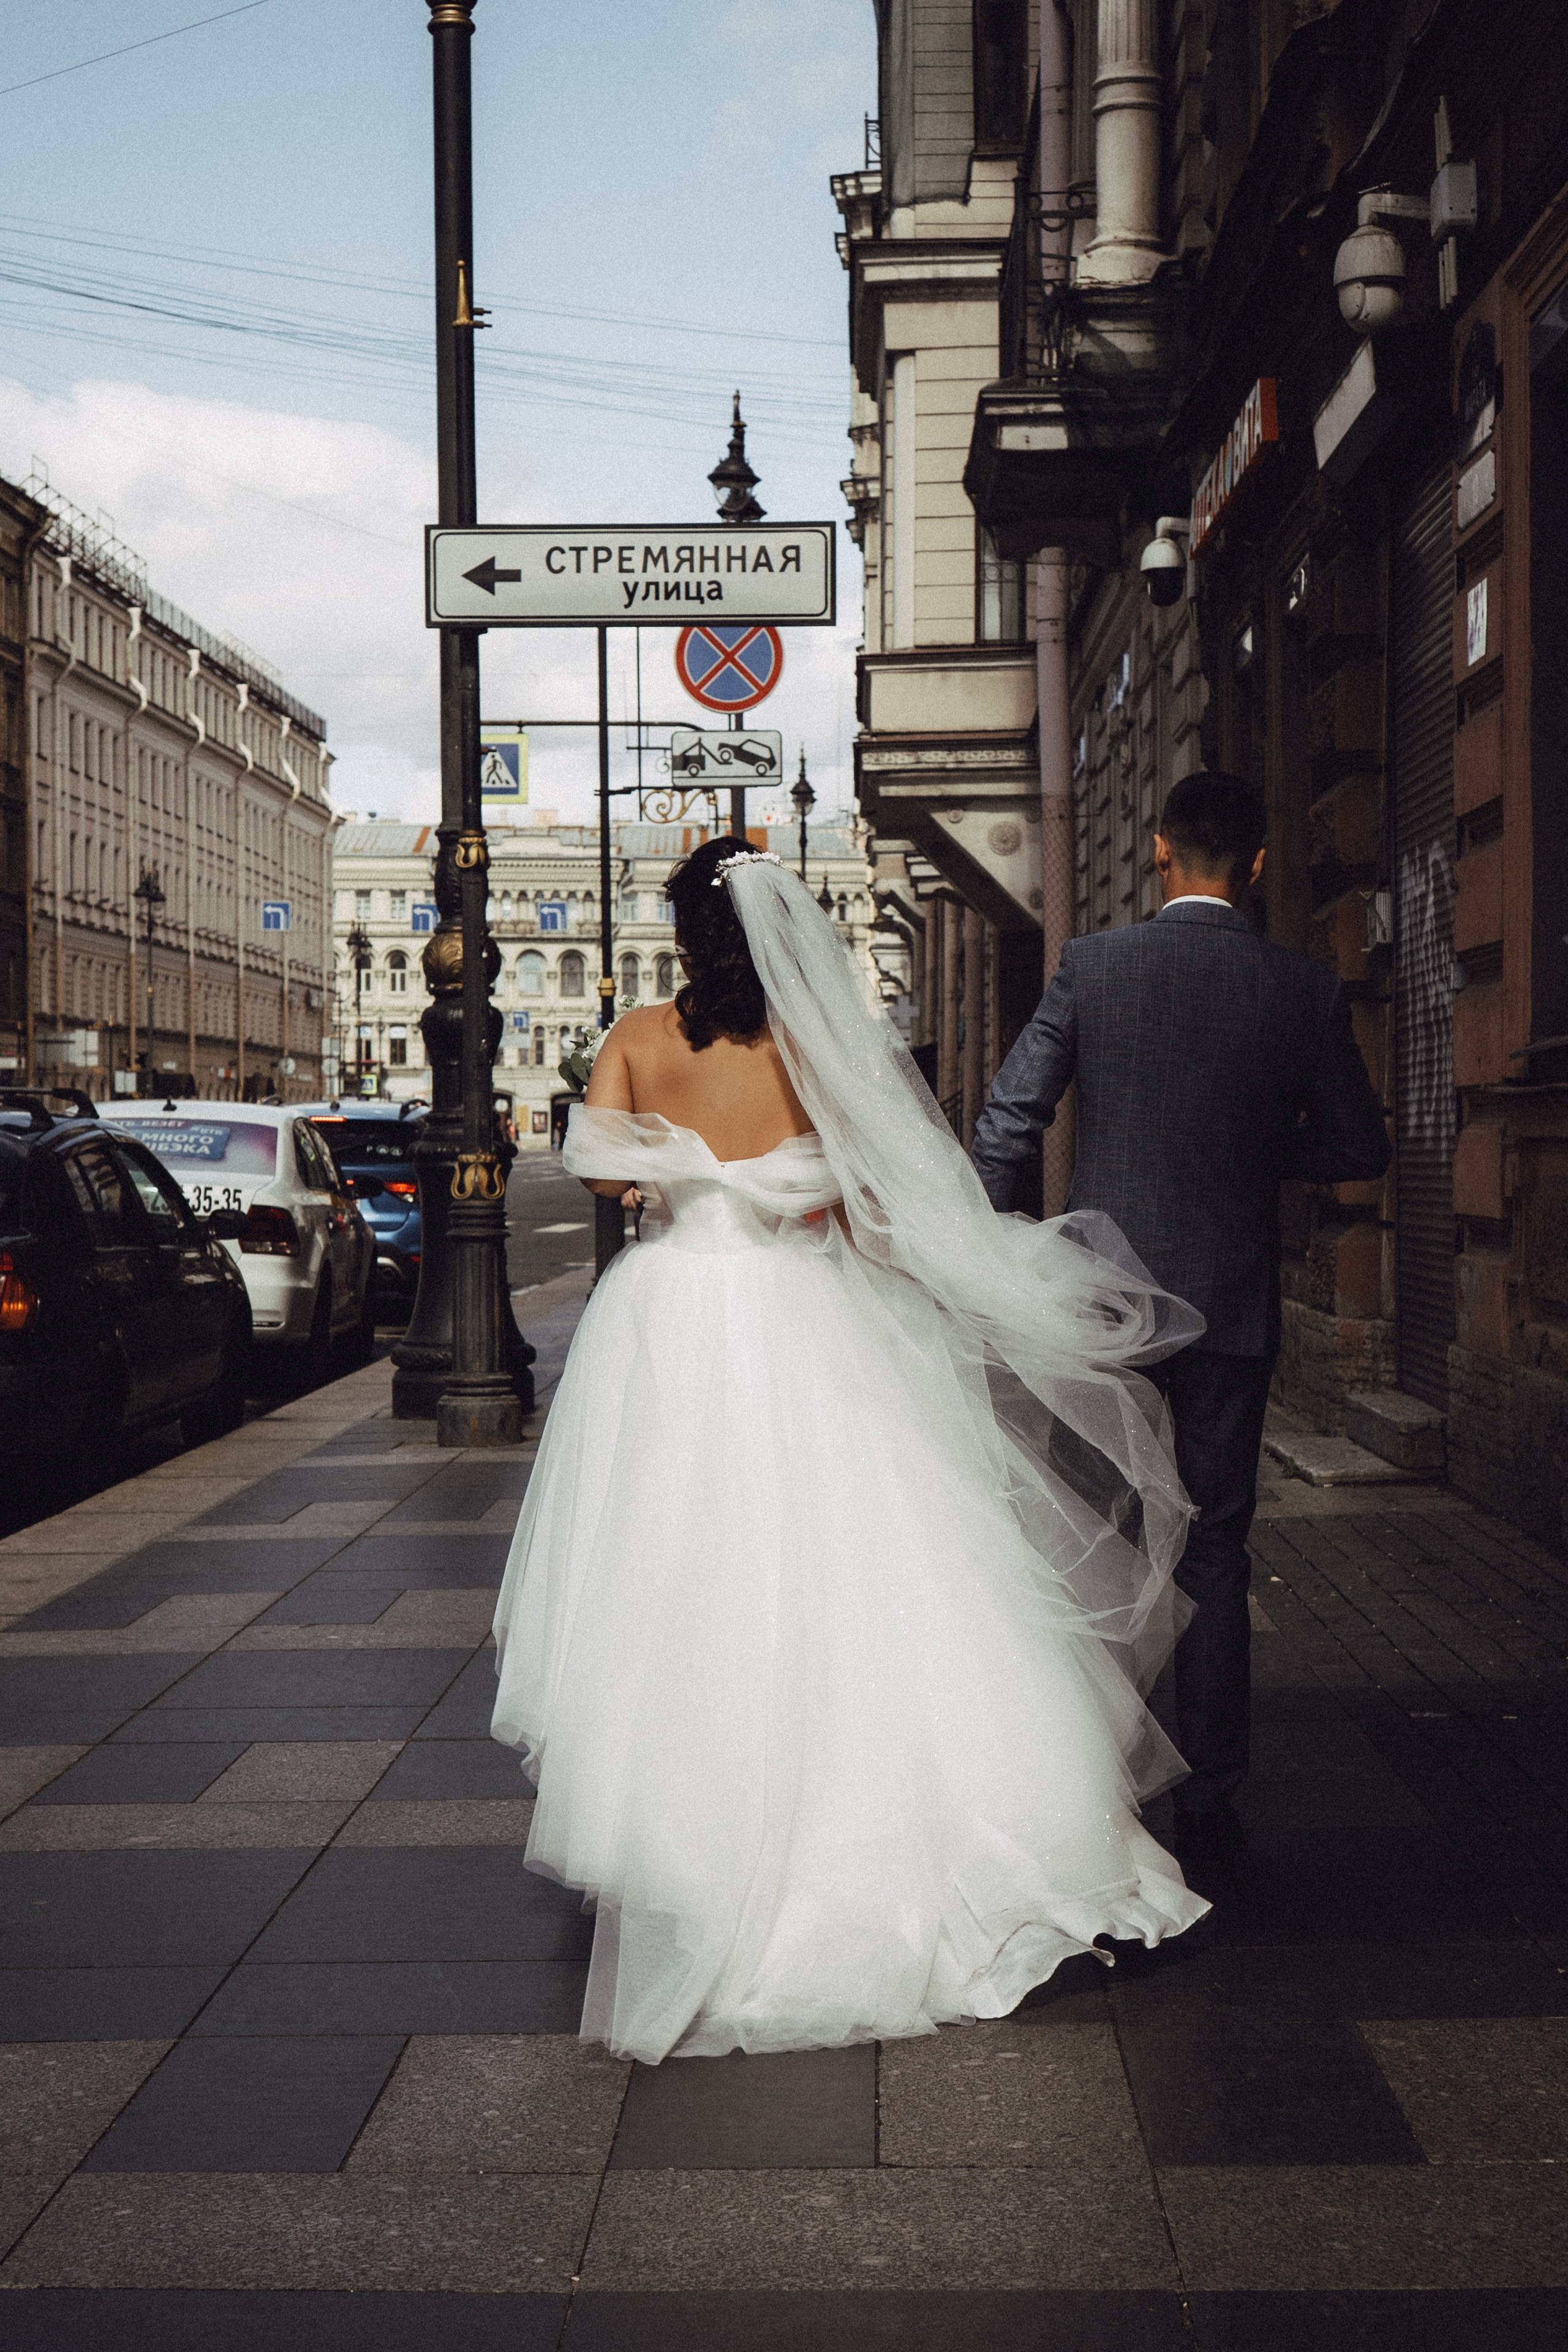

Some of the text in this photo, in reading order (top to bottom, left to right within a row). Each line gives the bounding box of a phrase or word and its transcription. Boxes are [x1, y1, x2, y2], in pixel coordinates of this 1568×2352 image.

[1233, 378, 1262, 487] ВИТА
[545, 545, 801, 574] СТРЕМЯННАЯ
[622, 580, 723, 609] улица
[141, 1133, 214, 1145] МНОГО
